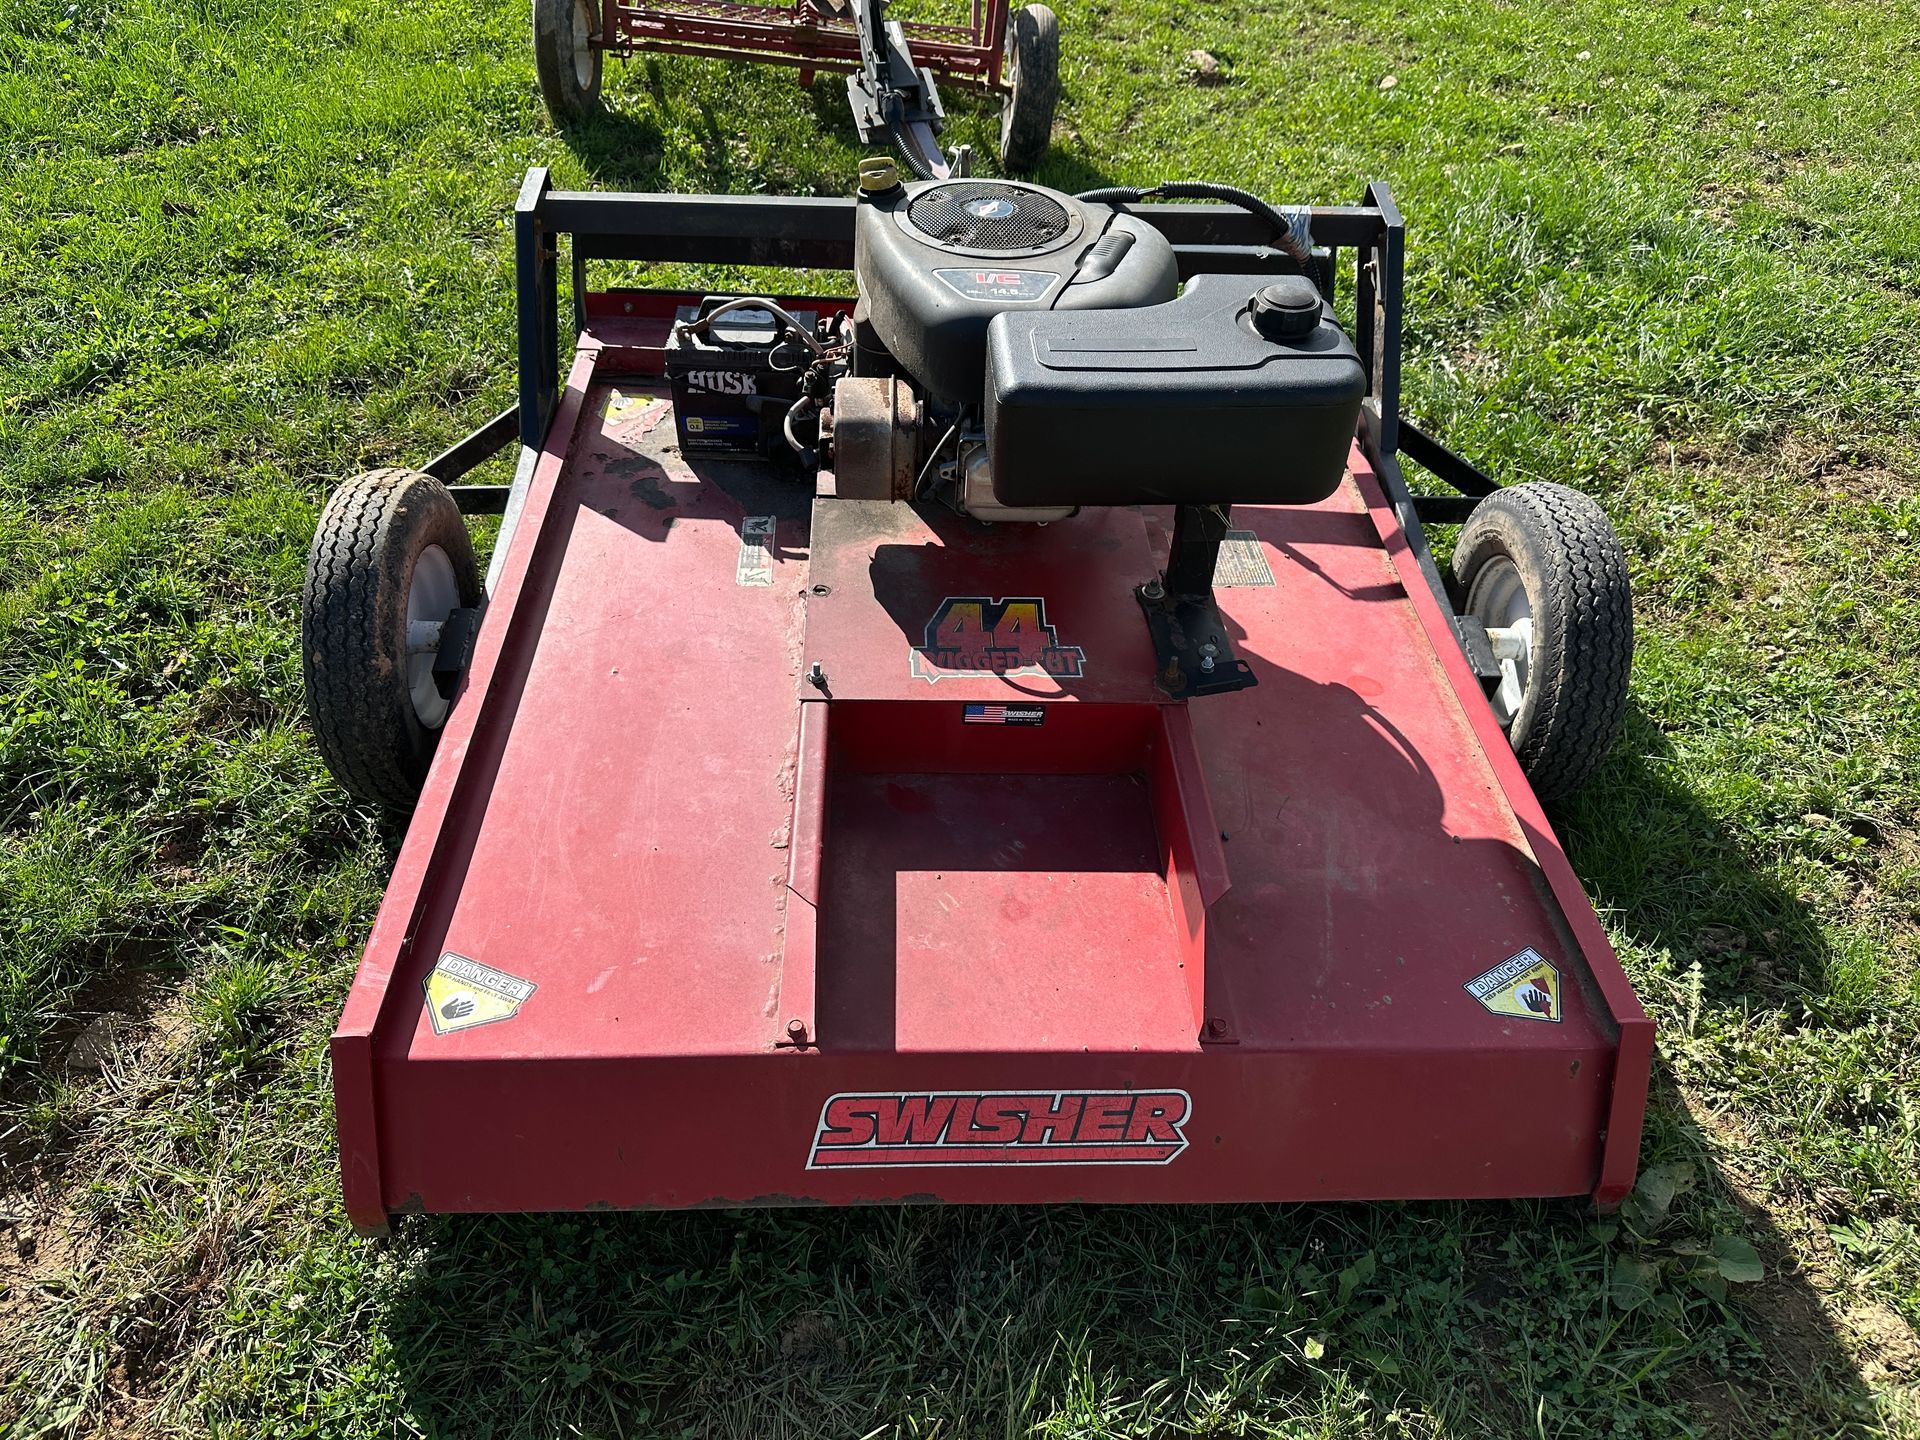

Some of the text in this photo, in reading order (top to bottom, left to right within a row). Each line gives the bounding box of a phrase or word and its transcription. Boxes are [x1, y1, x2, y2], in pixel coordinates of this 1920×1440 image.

[936, 602, 1050, 653] 44
[1002, 710, 1044, 718] SWISHER
[437, 972, 452, 980] KEEP
[452, 977, 472, 988] HANDS
[499, 994, 516, 1004] AWAY
[446, 959, 523, 996] DANGER
[1473, 954, 1535, 994] DANGER
[1484, 992, 1497, 1001] KEEP
[1496, 983, 1513, 994] HANDS
[1520, 970, 1532, 981] FEET
[815, 1094, 1187, 1144] SWISHER
